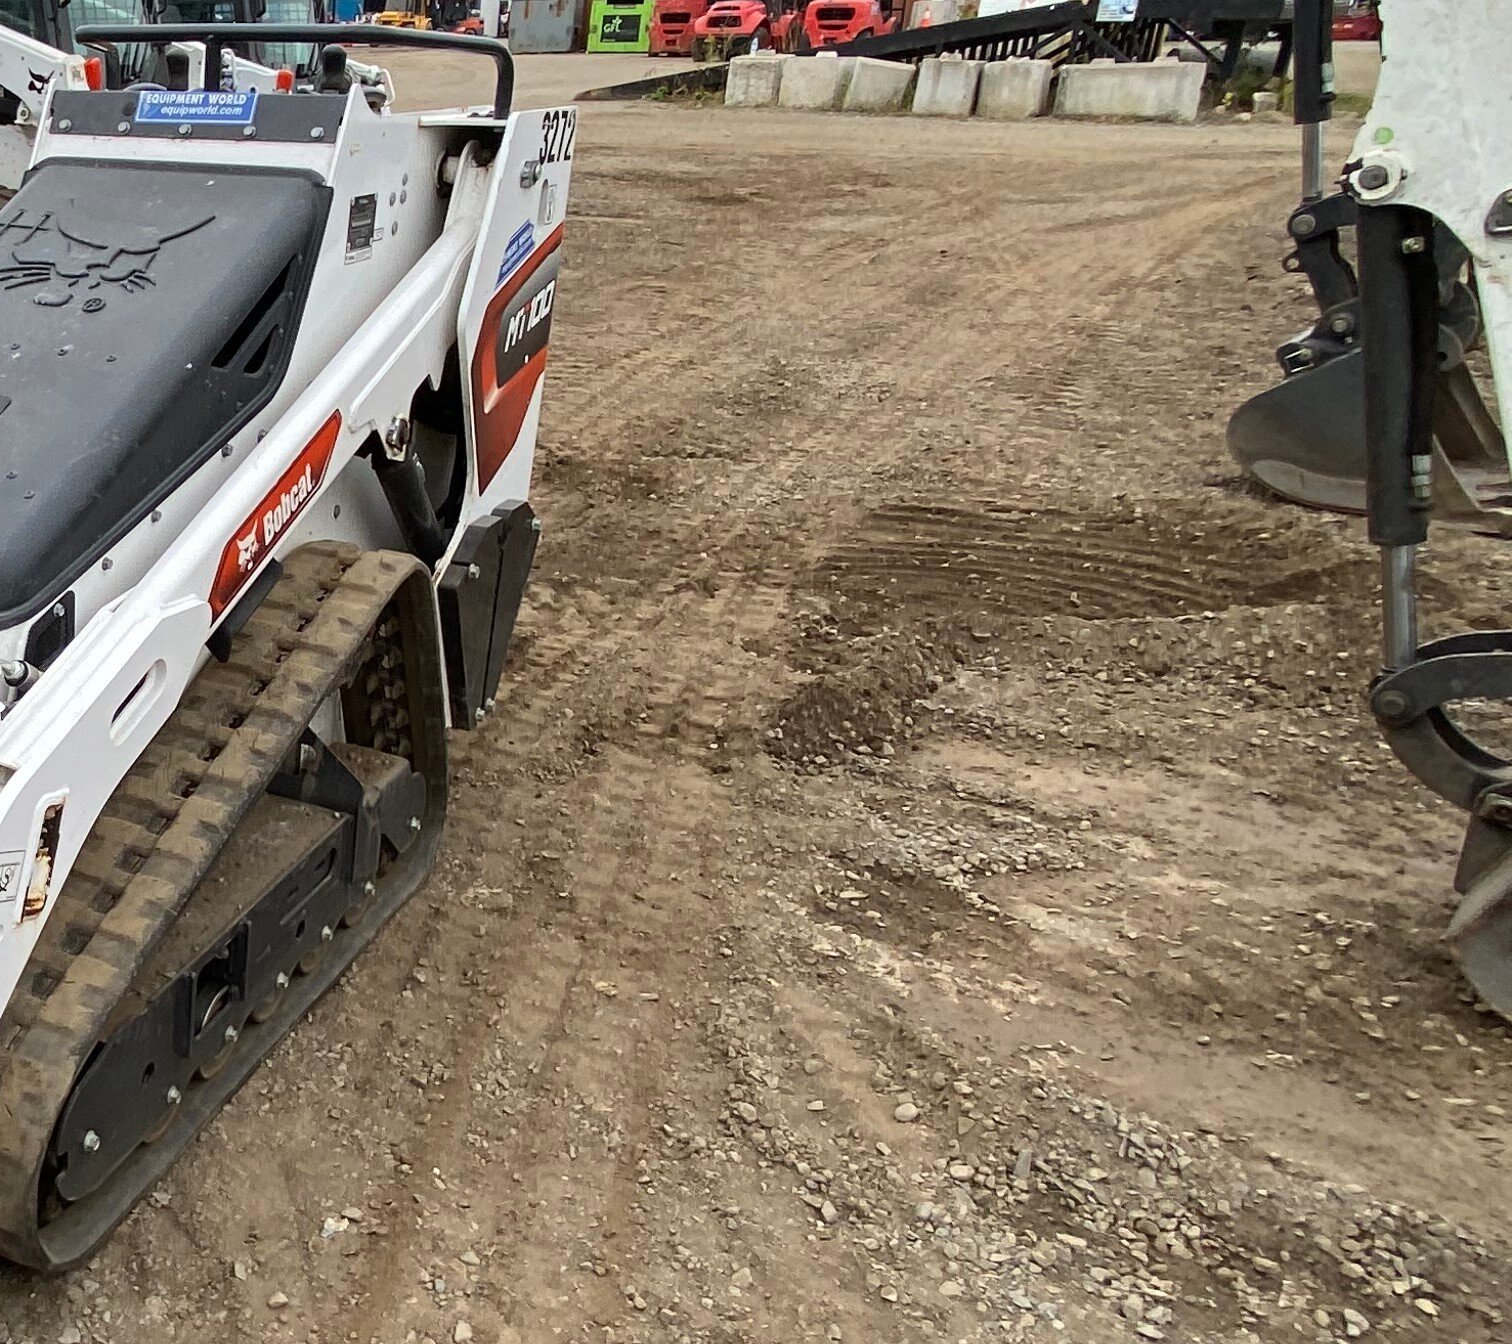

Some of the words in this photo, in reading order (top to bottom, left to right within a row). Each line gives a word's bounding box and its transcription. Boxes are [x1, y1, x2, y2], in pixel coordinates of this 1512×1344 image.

[146, 93, 206, 105] EQUIPMENT
[207, 94, 248, 106] WORLD
[159, 104, 244, 117] equipworld.com
[538, 109, 577, 166] 3272
[262, 462, 313, 546] Bobcat
